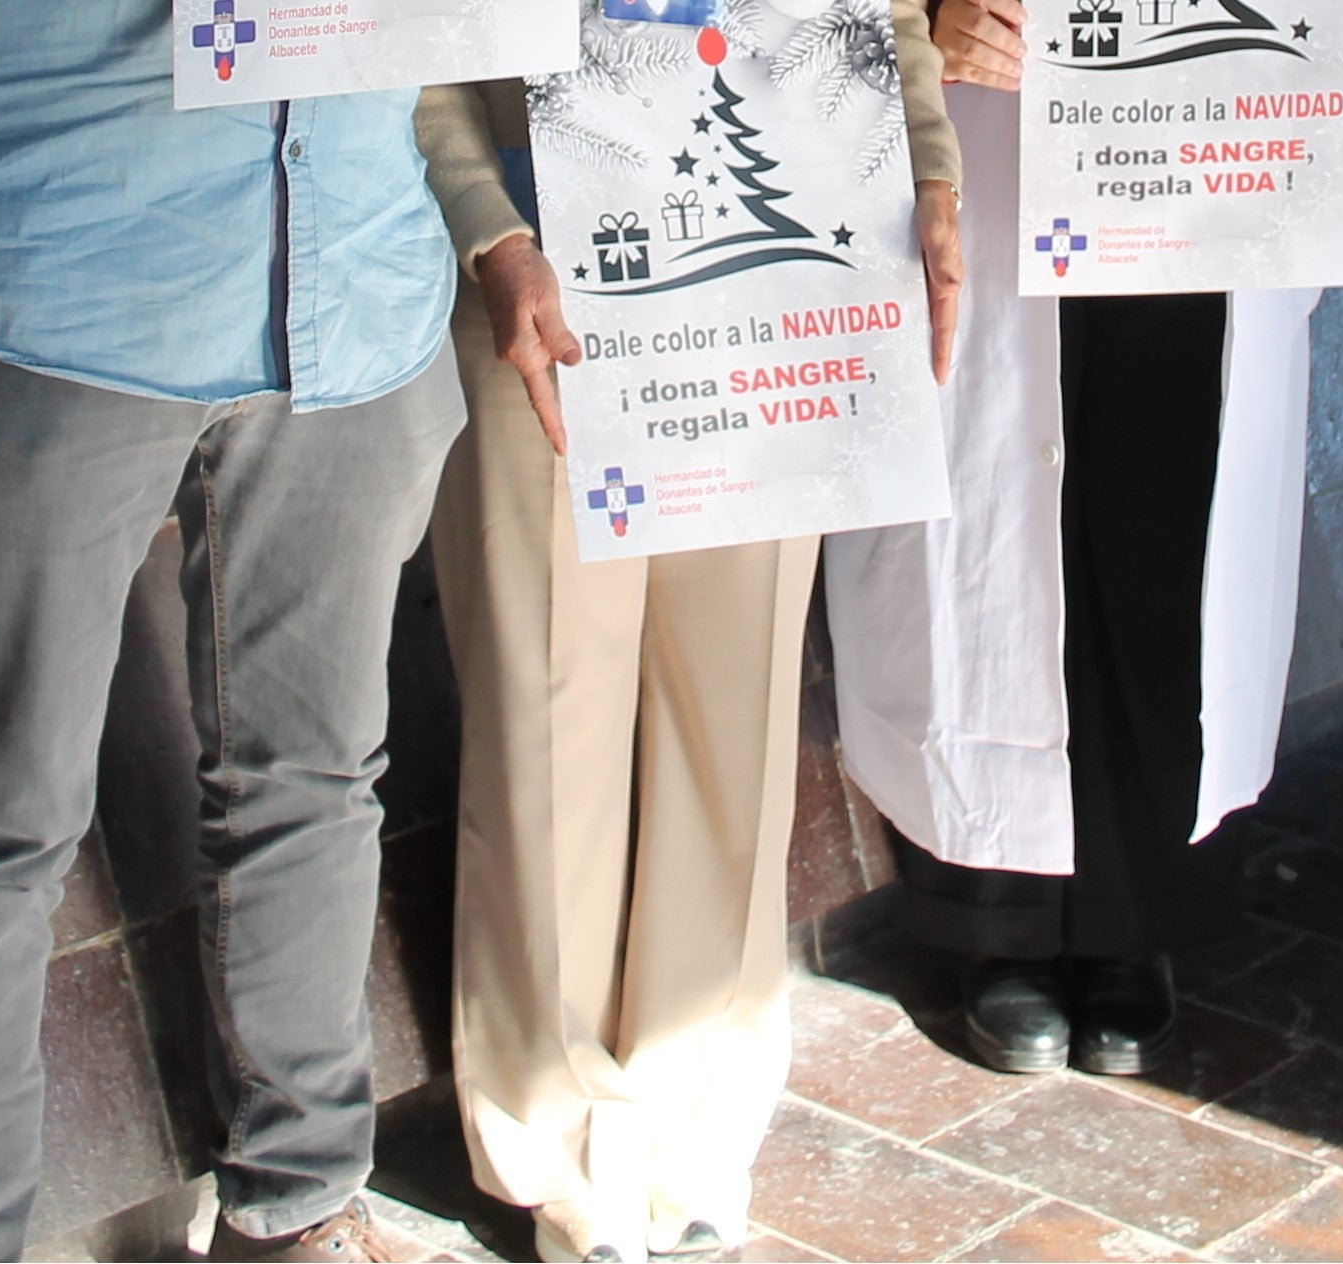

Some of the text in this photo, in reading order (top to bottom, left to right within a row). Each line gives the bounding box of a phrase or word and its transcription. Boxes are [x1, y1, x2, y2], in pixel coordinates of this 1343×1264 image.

[269, 3, 348, 21] Hermandad de
[269, 19, 377, 39] Donantes de Sangre
[269, 44, 317, 59] Albacete
[1049, 92, 1343, 124] Dale color a la NAVIDAD
[1096, 146, 1167, 165] dona
[1179, 140, 1314, 165] SANGRE,
[1097, 175, 1192, 201] regala
[1204, 172, 1275, 194] VIDA
[1098, 225, 1165, 235] Hermandad de
[1098, 238, 1190, 249] Donantes de Sangre
[1098, 254, 1138, 264] Albacete
[584, 302, 901, 360] Dale color a la NAVIDAD
[640, 380, 718, 404] dona
[729, 358, 876, 394] SANGRE,
[646, 410, 748, 441] regala
[759, 396, 838, 425] VIDA
[654, 467, 726, 484] Hermandad de
[656, 480, 755, 500] Donantes de Sangre
[658, 502, 702, 517] Albacete
